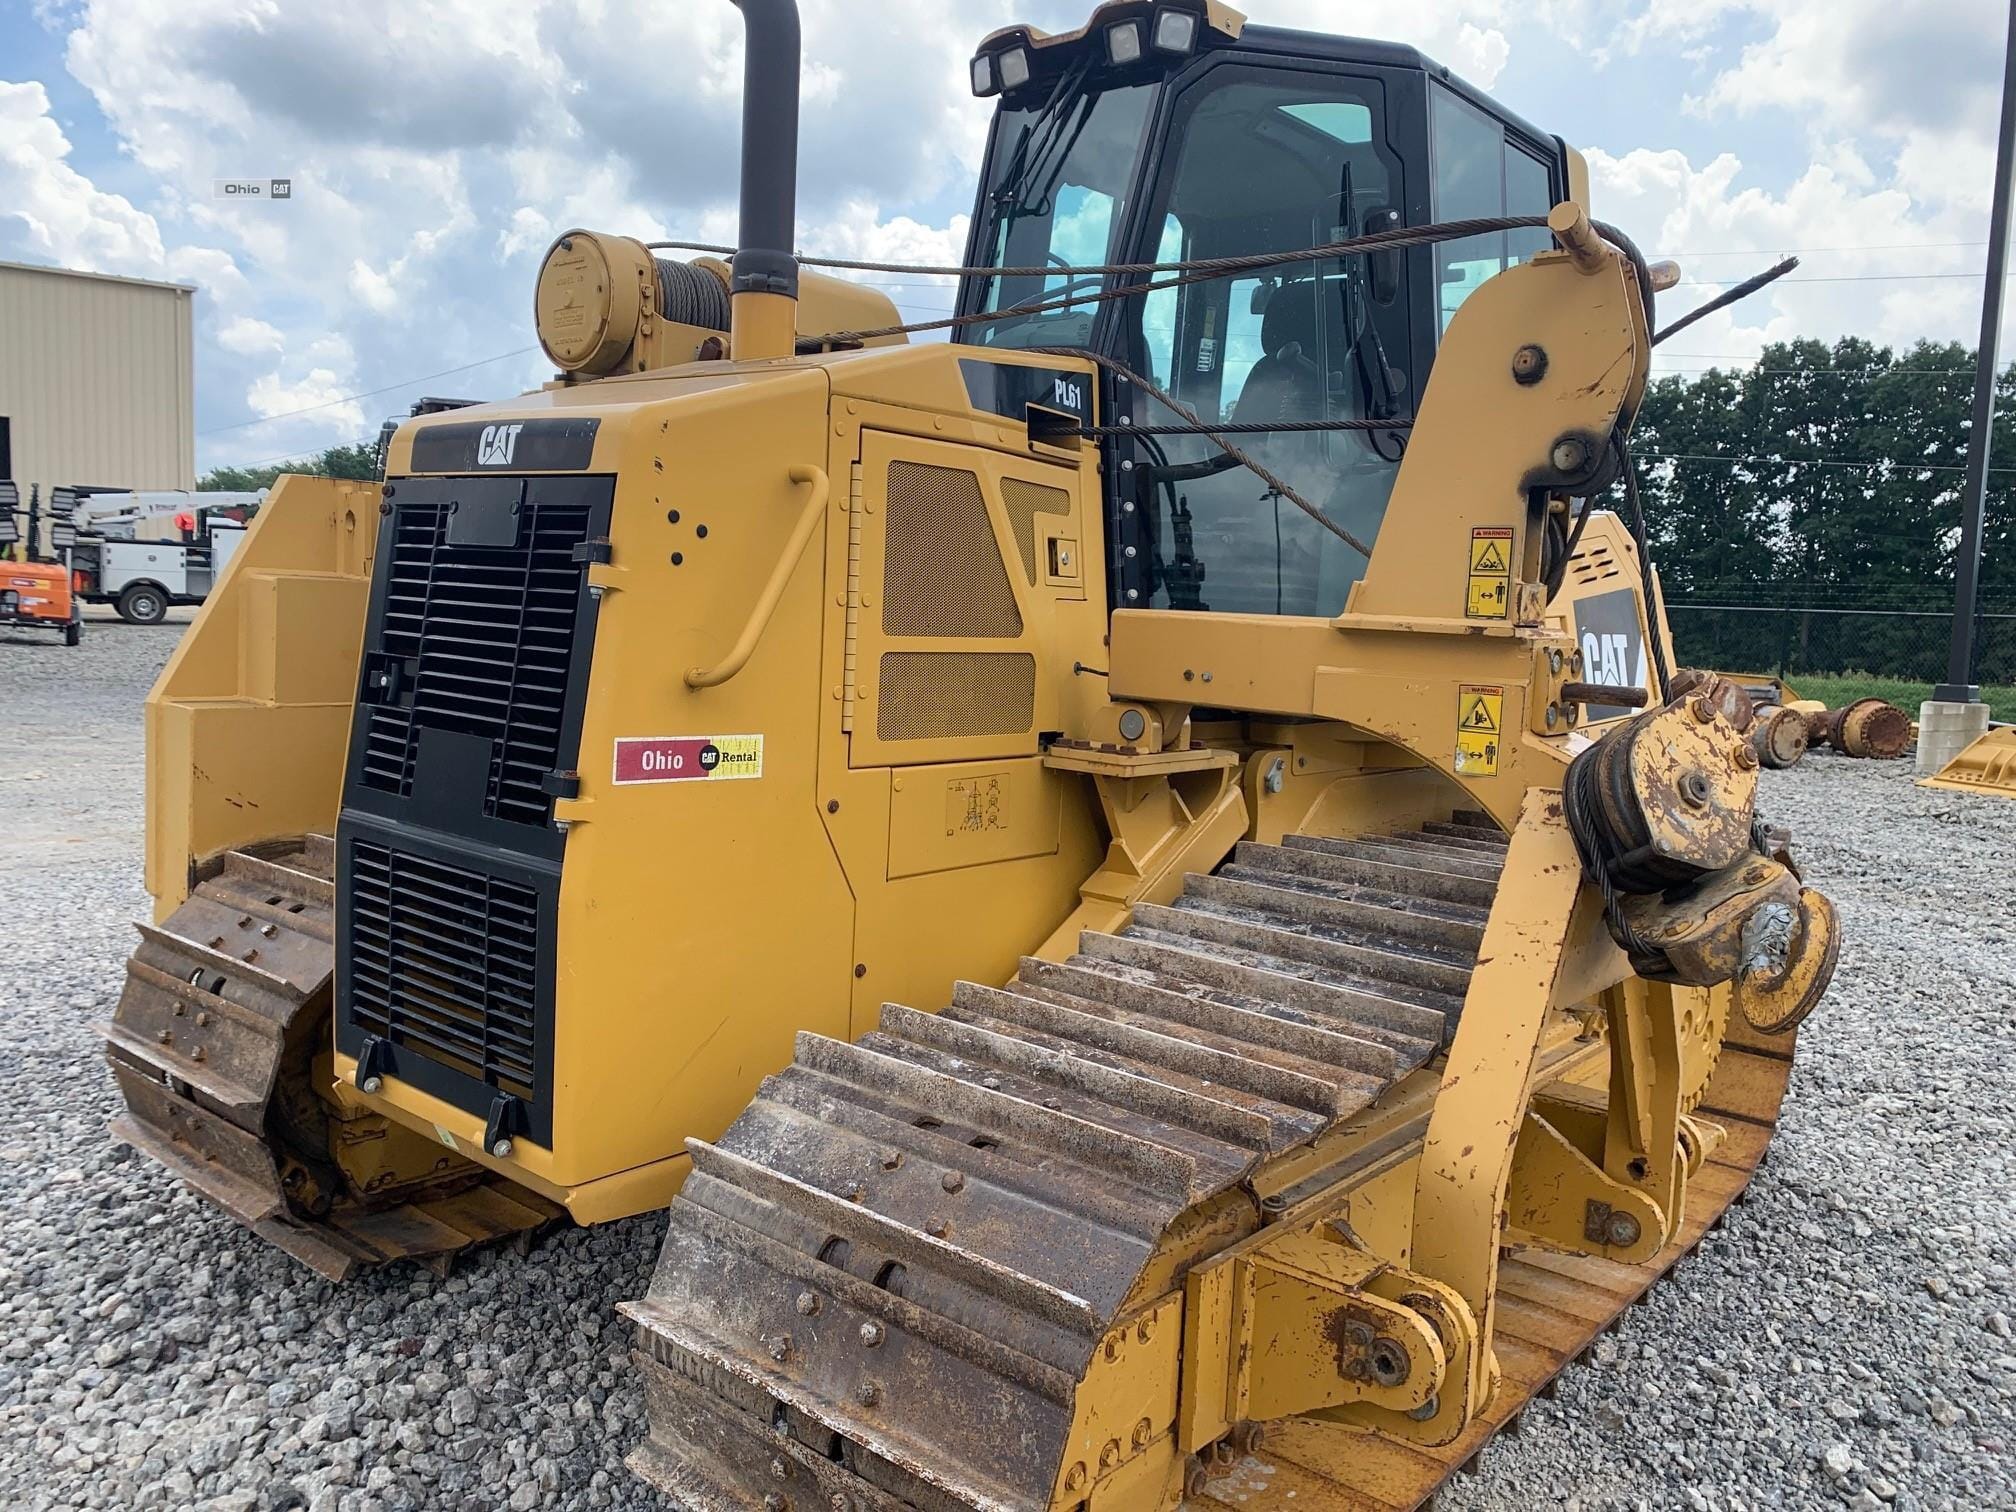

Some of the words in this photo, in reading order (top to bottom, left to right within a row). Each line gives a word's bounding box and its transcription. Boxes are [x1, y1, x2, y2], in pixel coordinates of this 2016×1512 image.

[1054, 378, 1081, 410] PL61
[477, 424, 525, 465] CAT
[1583, 632, 1628, 687] CAT
[1471, 687, 1500, 695] WARNING
[642, 750, 684, 771] Ohio
[702, 752, 717, 764] CAT
[721, 752, 757, 763] Rental
